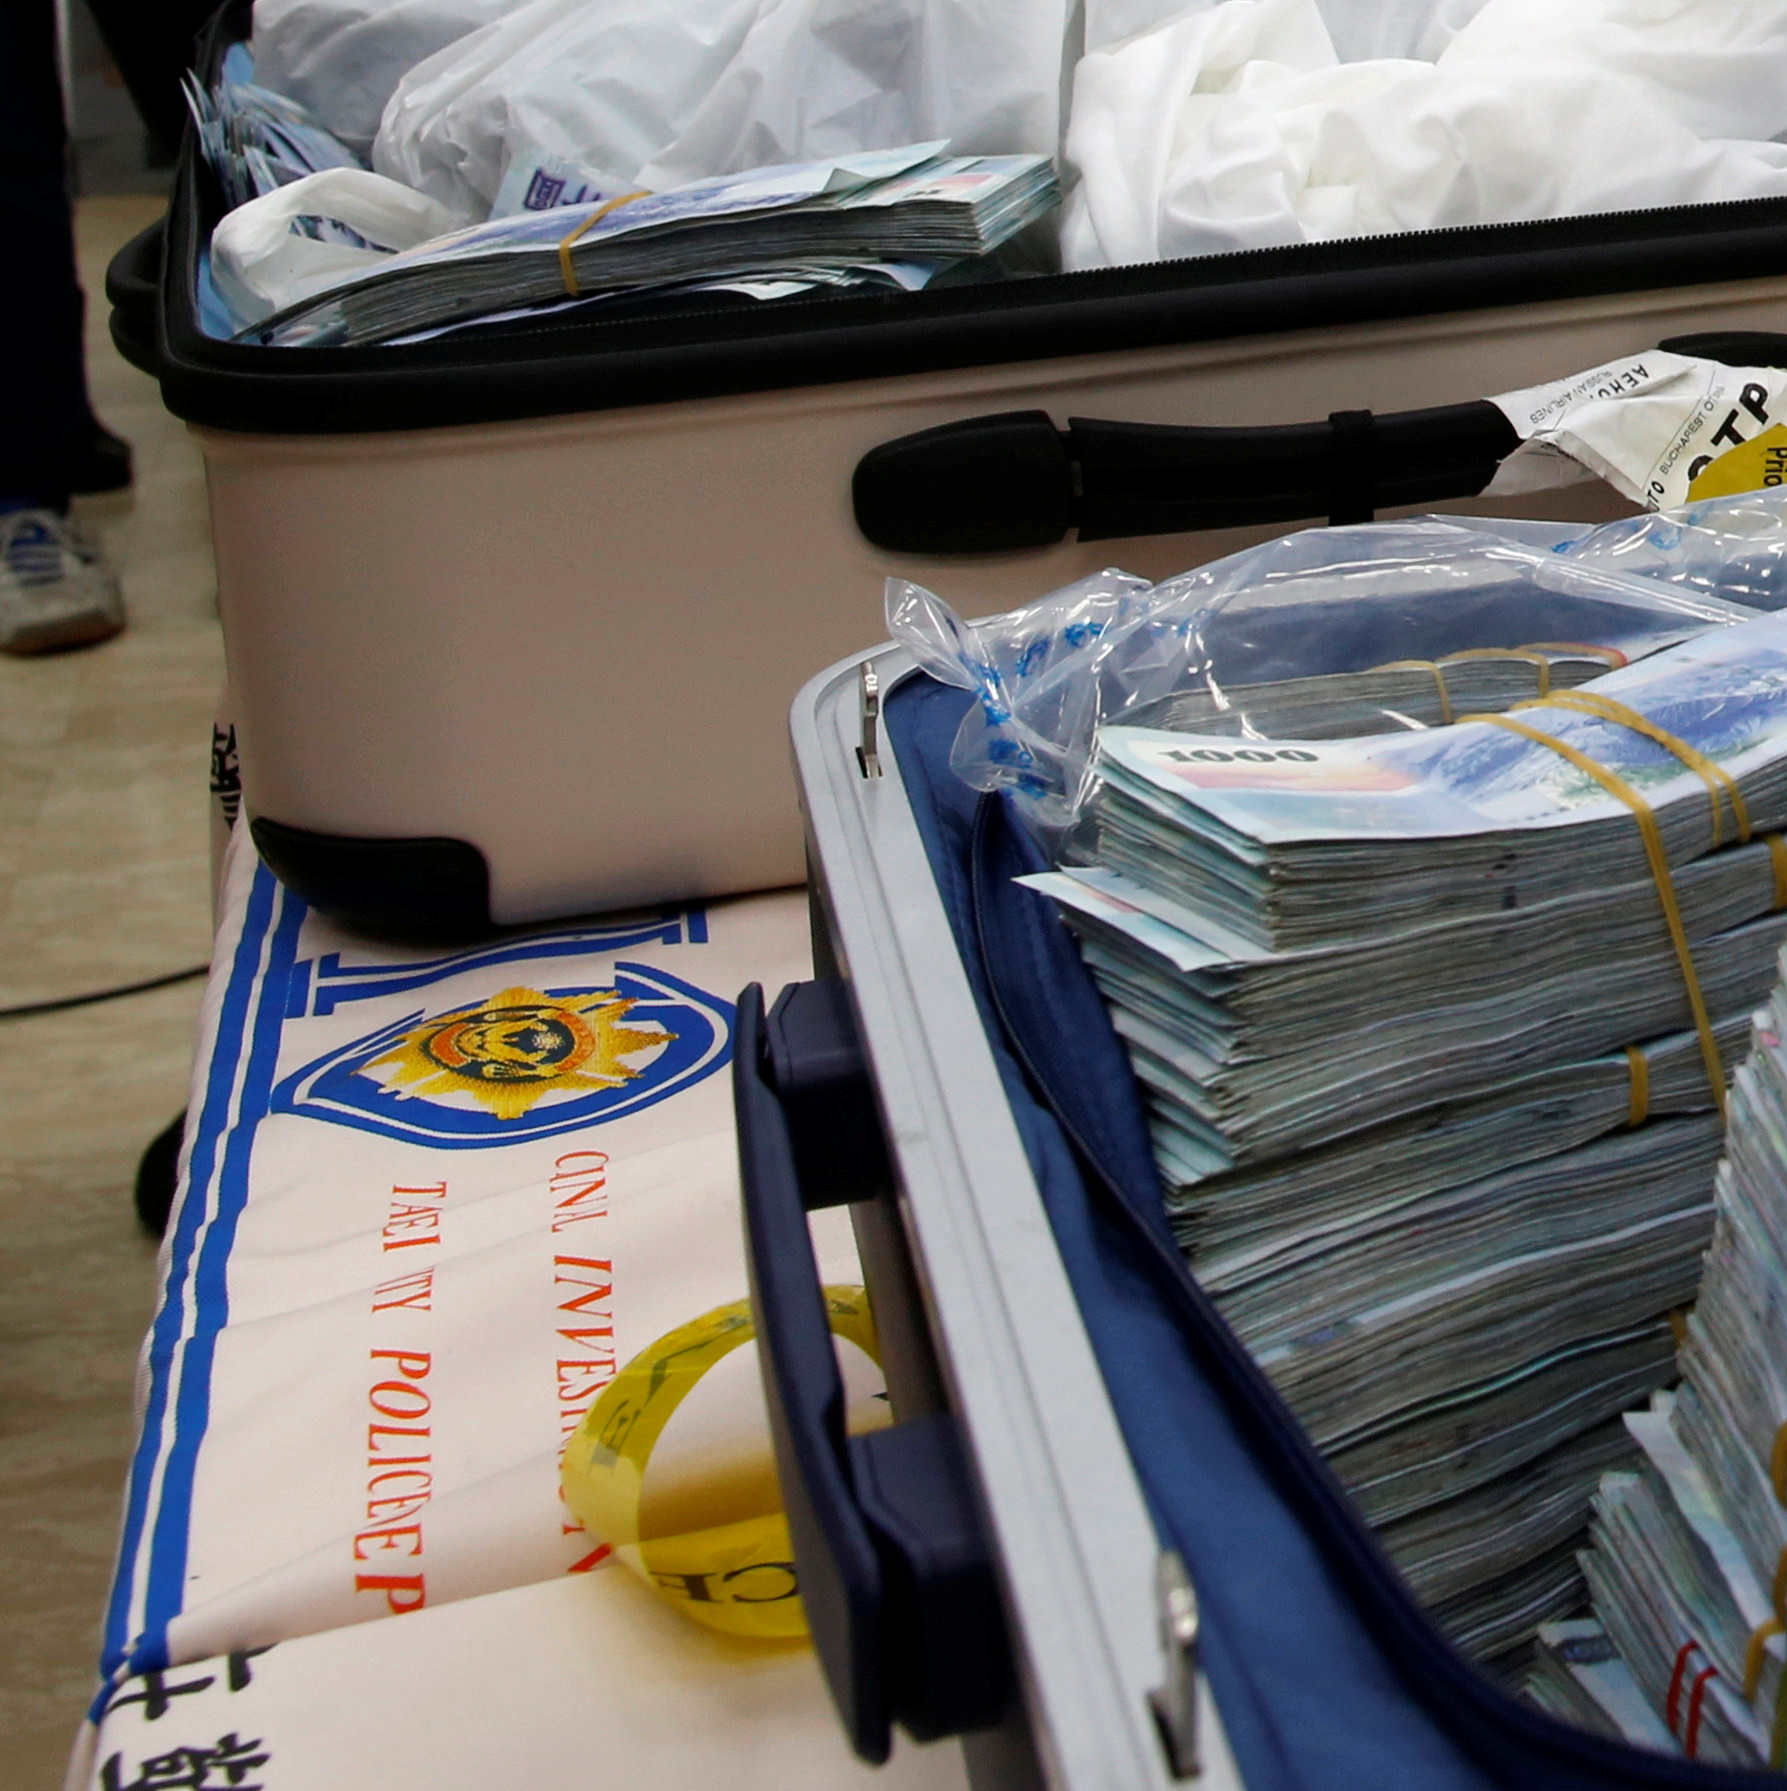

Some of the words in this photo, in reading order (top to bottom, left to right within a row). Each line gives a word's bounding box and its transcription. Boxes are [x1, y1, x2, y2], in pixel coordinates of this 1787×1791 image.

[1529, 394, 1579, 426] AIRLINES
[1659, 411, 1707, 475] BUCHAREST
[1155, 742, 1321, 769] 1000
